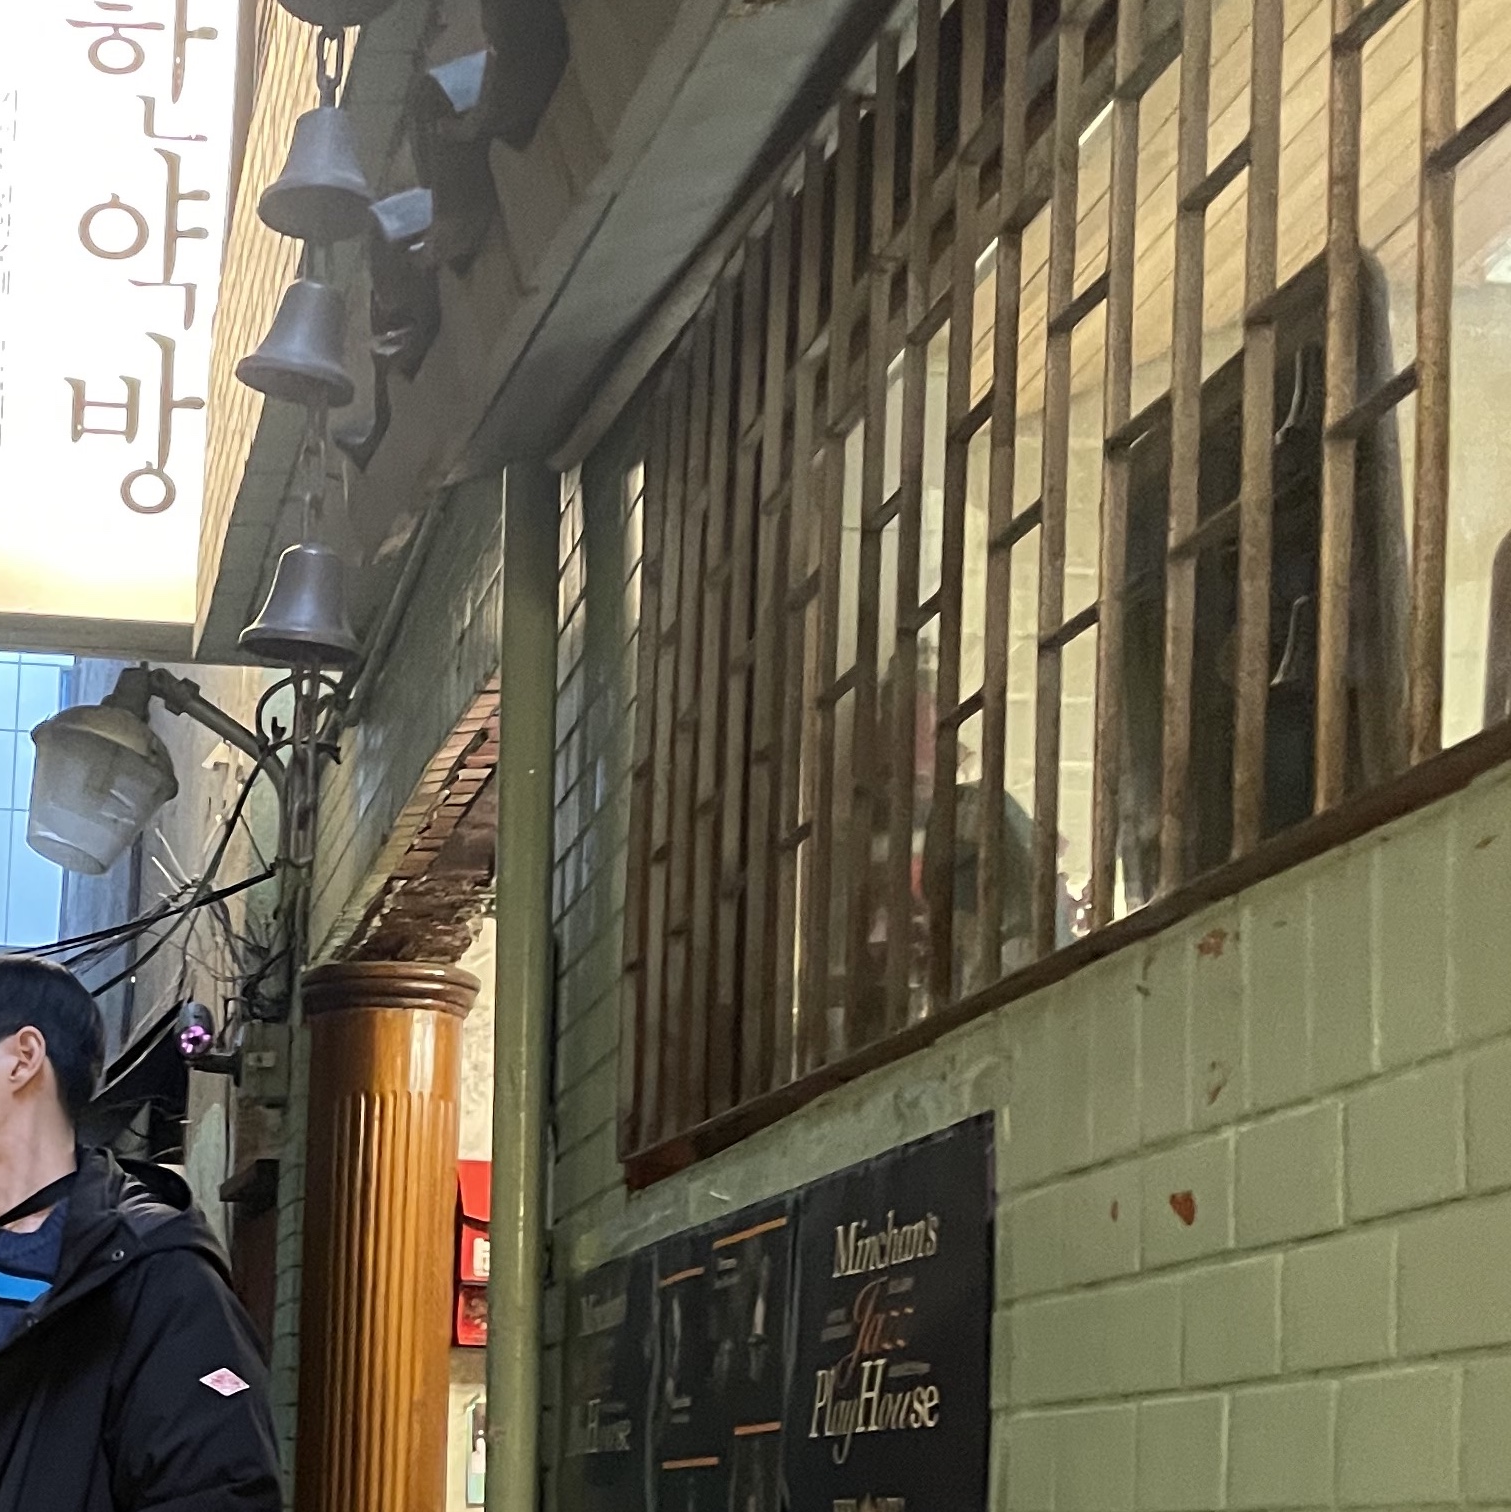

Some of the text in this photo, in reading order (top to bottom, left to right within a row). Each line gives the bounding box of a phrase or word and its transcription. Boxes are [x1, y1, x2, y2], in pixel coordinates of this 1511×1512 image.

[63, 0, 218, 514] 한약방
[831, 1209, 939, 1278] Minchan's
[808, 1358, 940, 1464] PlayHouse
